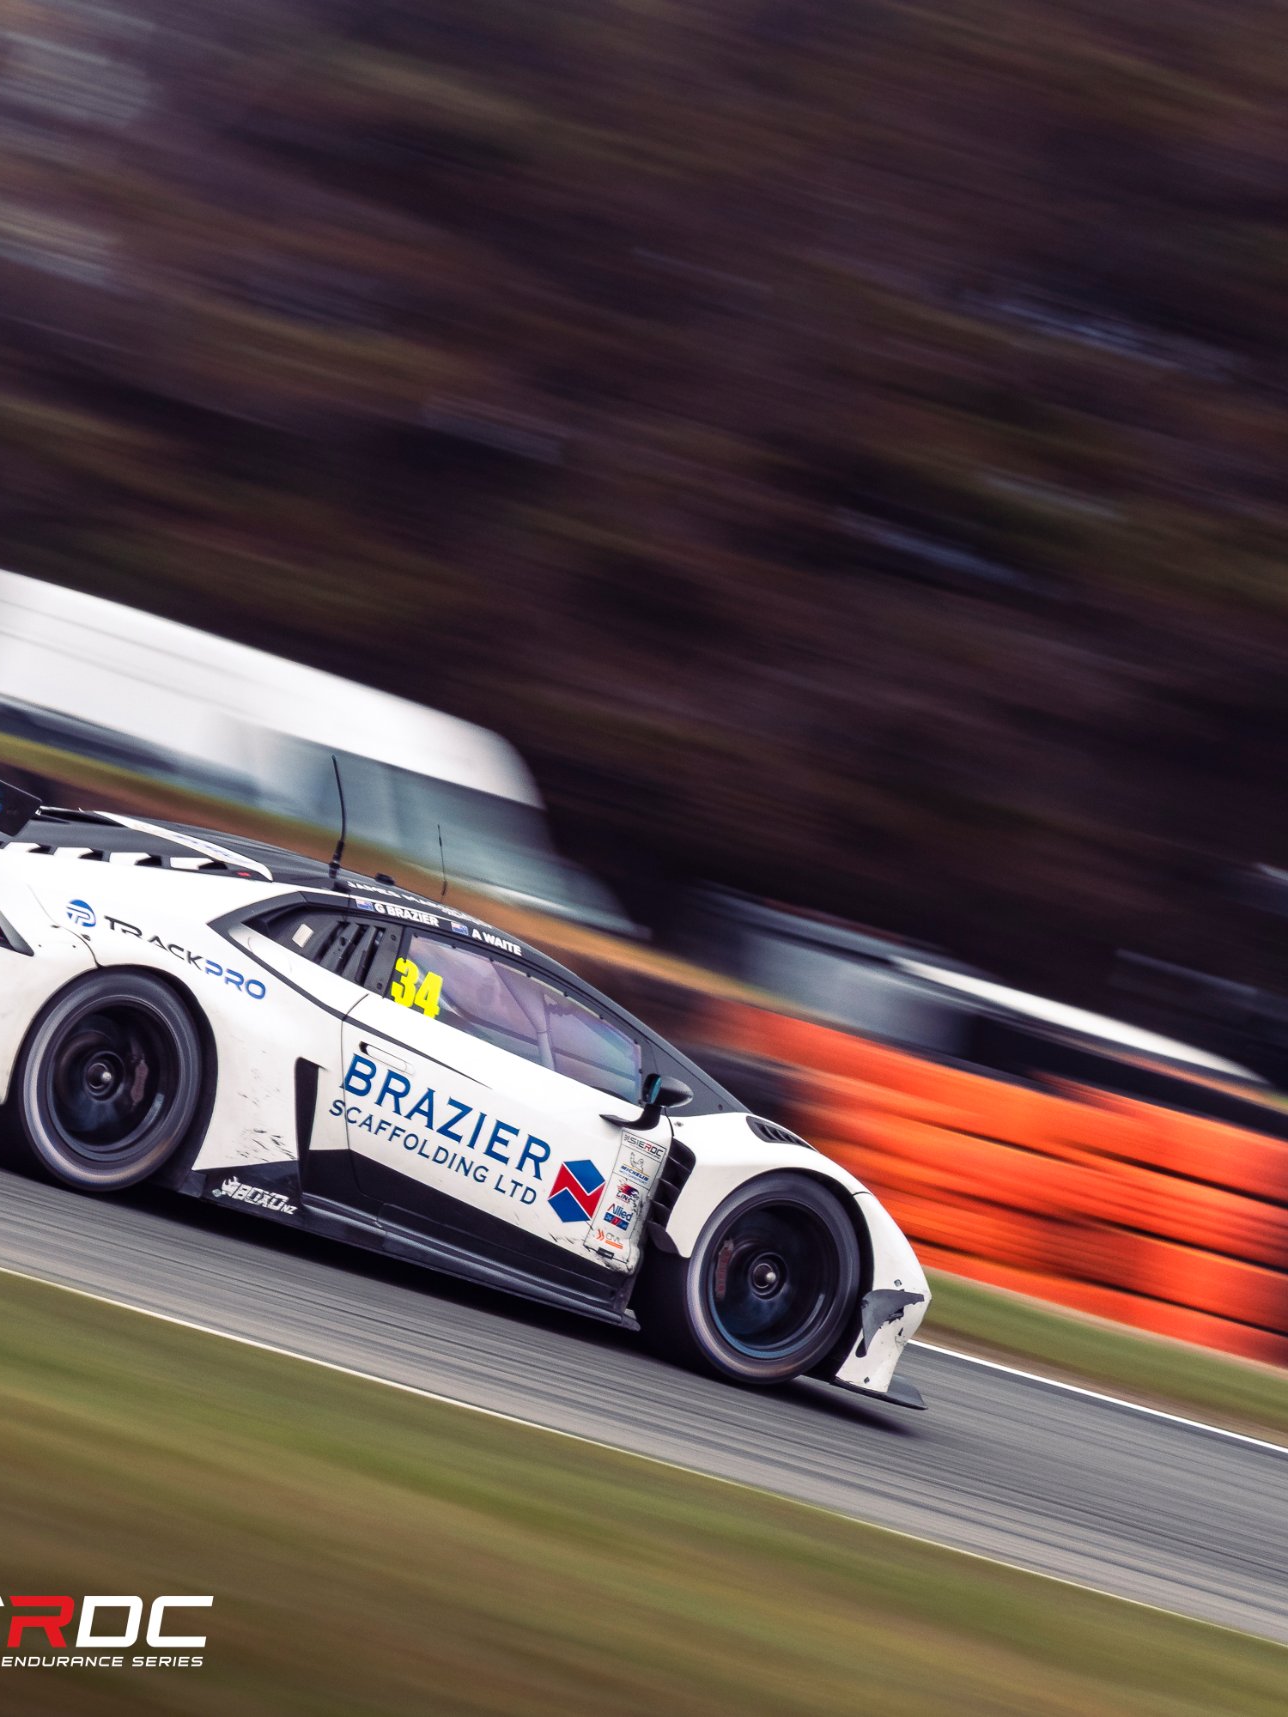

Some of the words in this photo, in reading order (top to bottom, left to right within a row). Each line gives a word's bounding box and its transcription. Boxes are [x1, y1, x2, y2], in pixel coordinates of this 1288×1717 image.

[374, 903, 386, 914] G
[388, 905, 440, 927] BRAZIER
[471, 929, 483, 940] A
[483, 931, 523, 956] WAITE
[104, 915, 266, 1000] TRACKPRO
[390, 957, 443, 1021] 34
[340, 1054, 551, 1180] BRAZIER
[329, 1099, 490, 1184] SCAFFOLDING
[495, 1177, 538, 1206] LTD
[627, 1135, 664, 1157] SIERDC
[620, 1165, 649, 1182] MICHELIN
[607, 1203, 633, 1221] Allied
